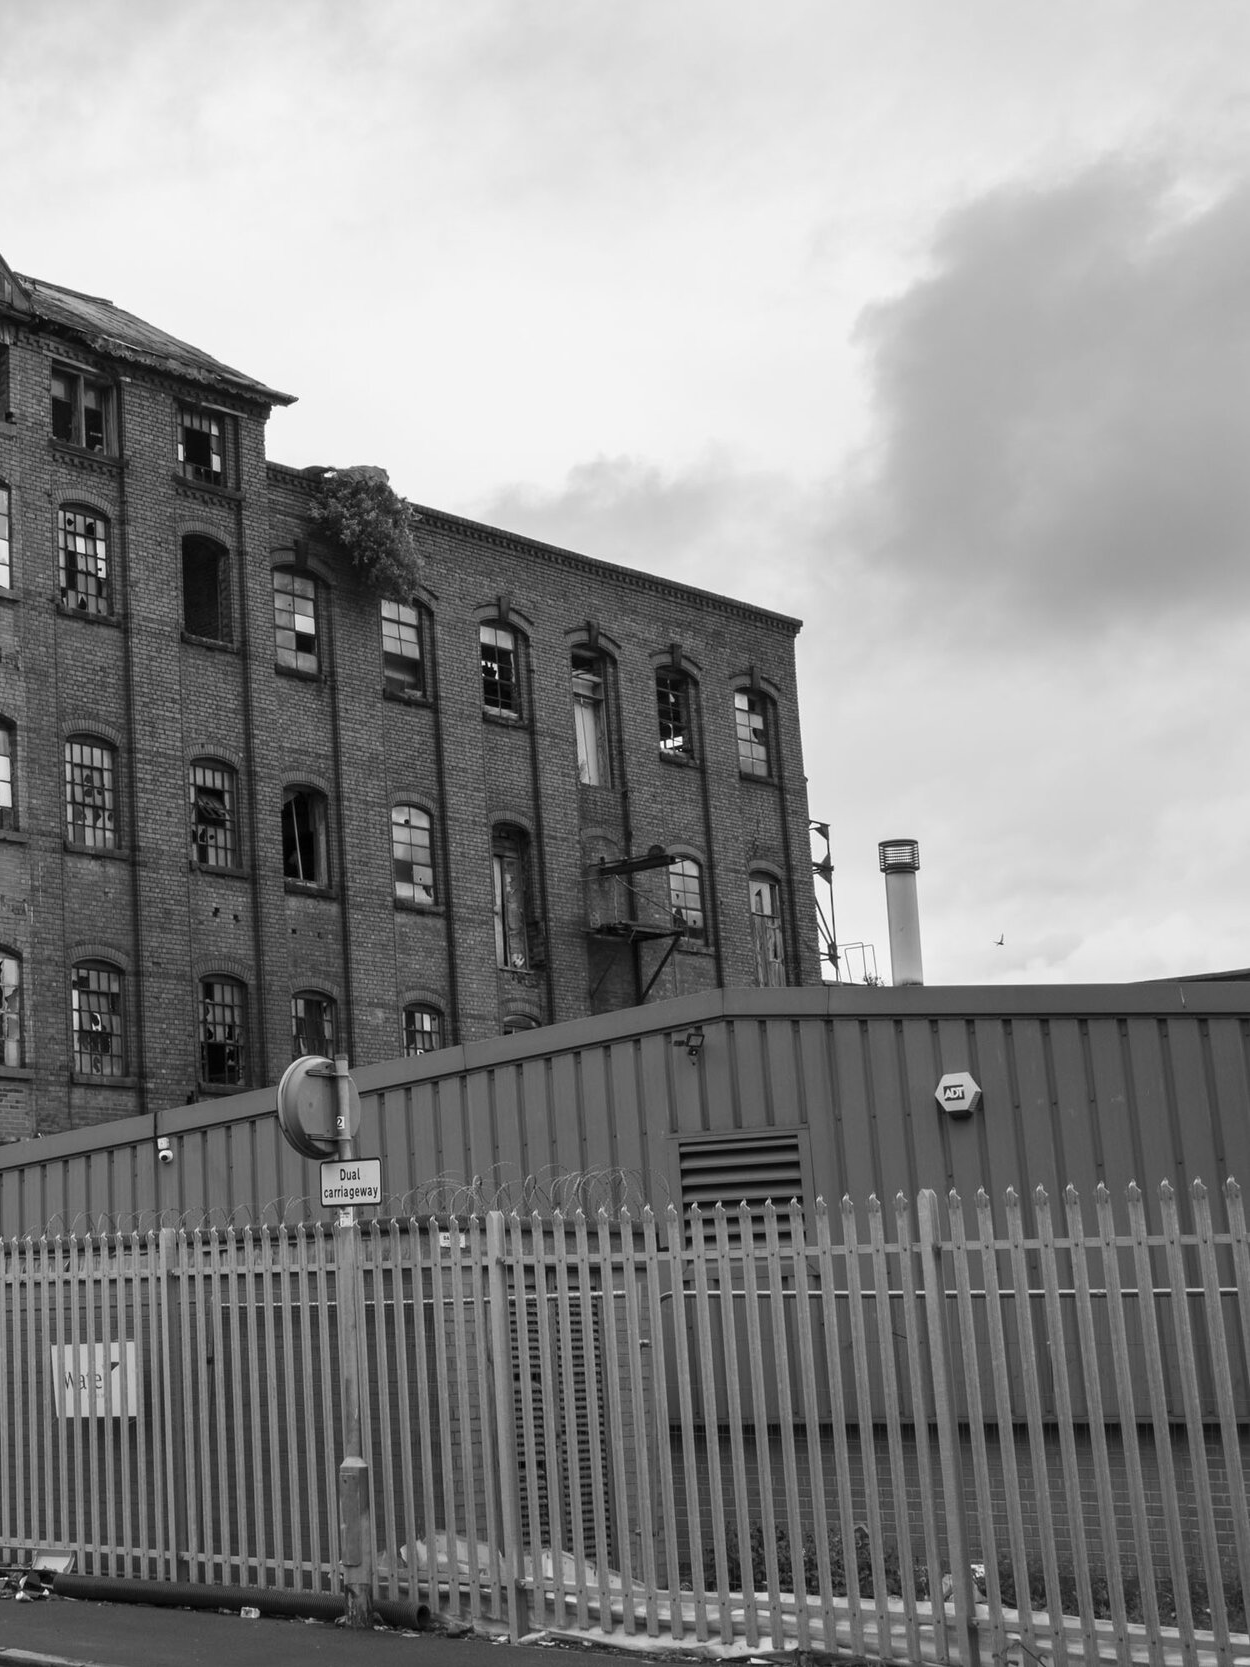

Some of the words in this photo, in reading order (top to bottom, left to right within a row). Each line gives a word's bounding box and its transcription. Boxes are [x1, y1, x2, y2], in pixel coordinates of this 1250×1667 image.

[943, 1086, 965, 1100] ADT
[339, 1168, 361, 1181] Dual
[323, 1185, 379, 1200] carriageway
